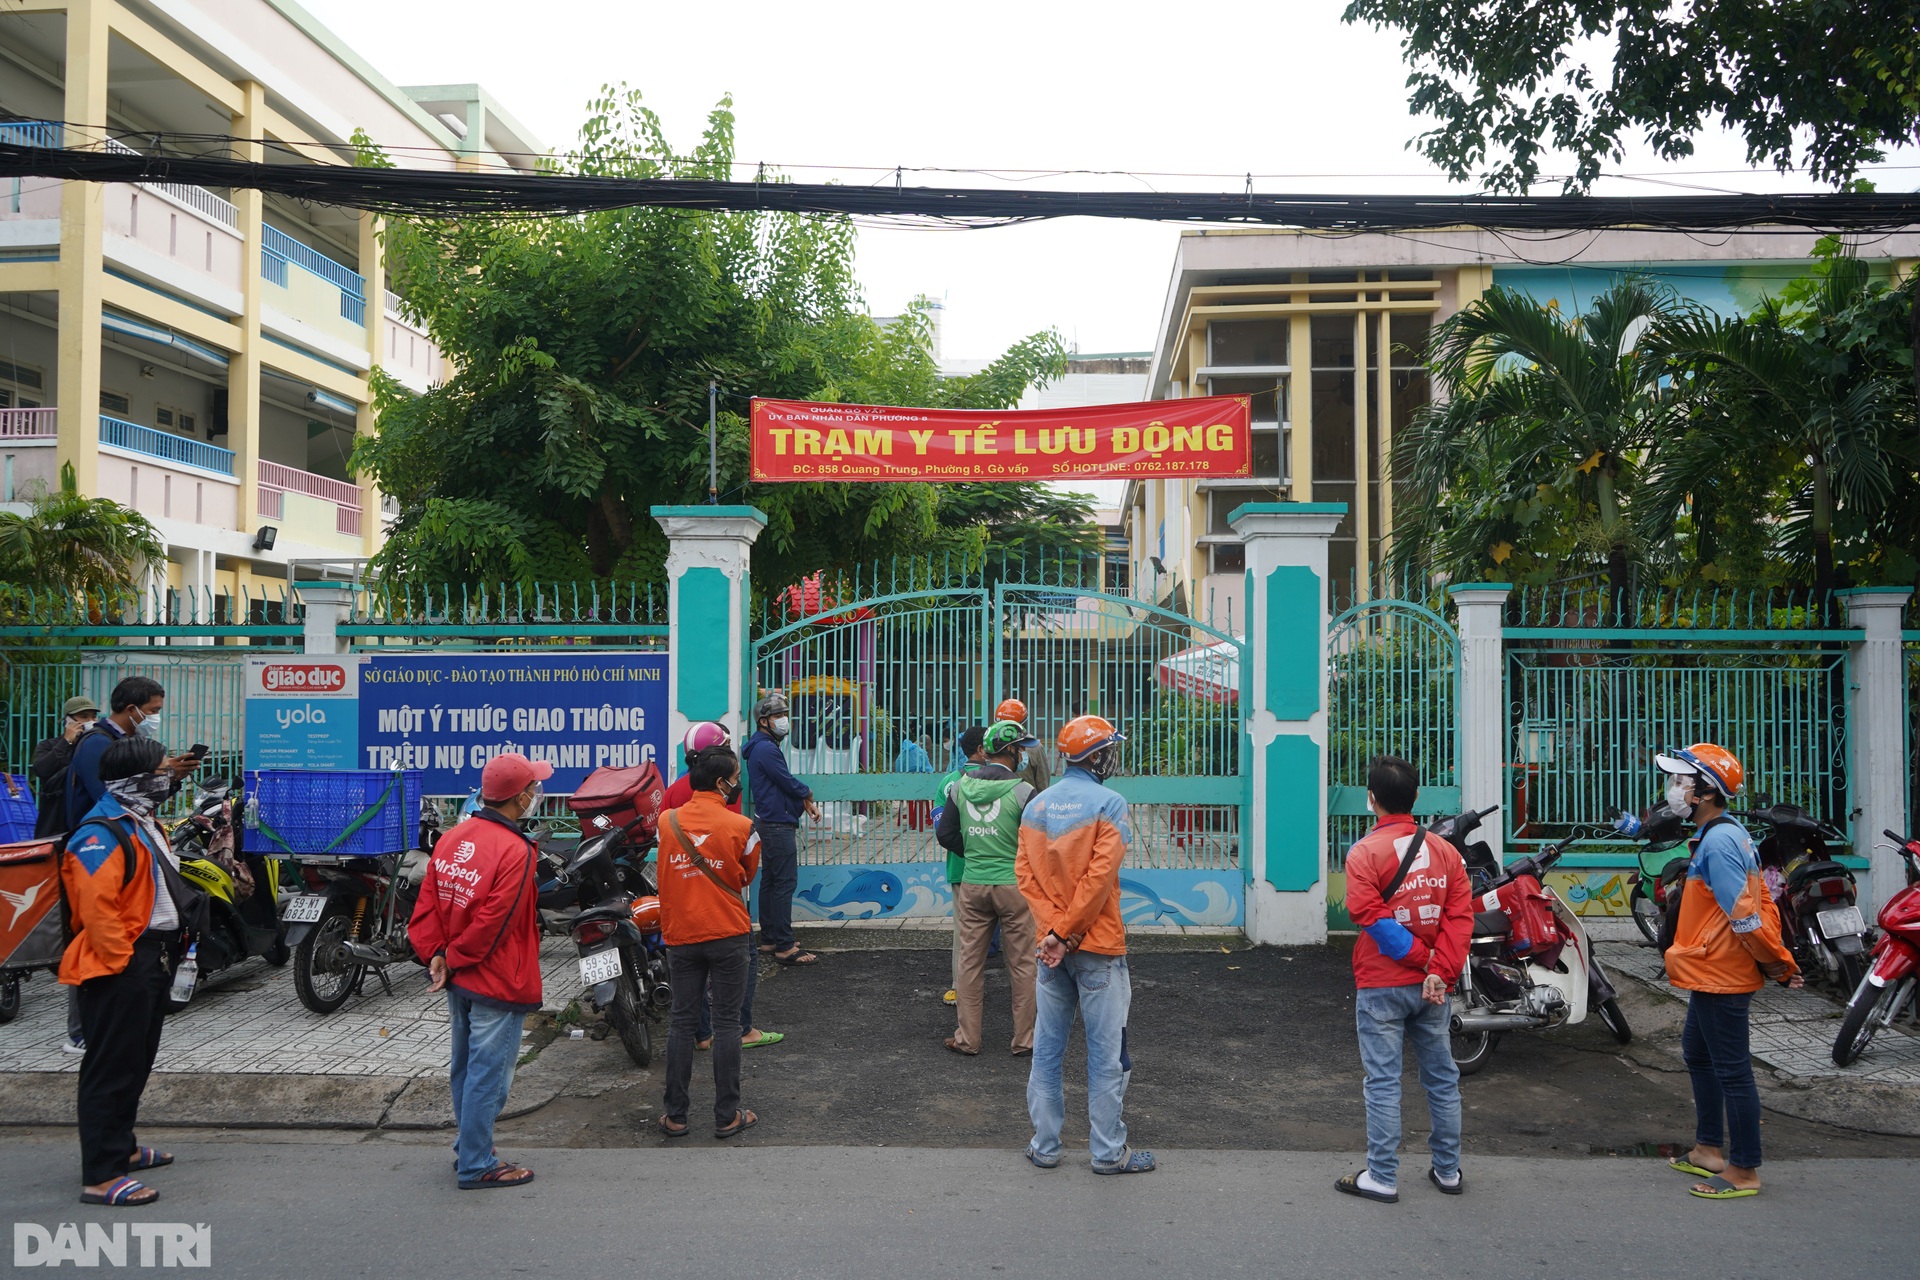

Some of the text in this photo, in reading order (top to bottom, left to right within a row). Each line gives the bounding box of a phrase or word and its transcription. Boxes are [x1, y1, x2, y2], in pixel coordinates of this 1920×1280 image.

[768, 412, 783, 421] ỦY
[812, 414, 843, 422] NHÂN
[846, 414, 869, 422] DÂN
[872, 414, 919, 422] PHƯỜNG
[864, 406, 886, 414] VẤP
[768, 420, 1234, 461] TRẠM Y TẾ LƯU ĐỘNG
[793, 462, 1029, 476] ĐC: 858 Quang Trung, Phường 8, Gò vấp
[1052, 460, 1210, 473] SỐ HOTLINE: 0762.187.178
[266, 667, 341, 690] giáo dục
[364, 667, 381, 684] SỞ
[383, 666, 415, 684] GIÁO
[416, 670, 442, 686] DỤC
[451, 666, 478, 683] ĐÀO
[480, 669, 506, 686] TẠO
[508, 666, 551, 682] THÀNH
[553, 665, 579, 682] PHỐ
[581, 665, 600, 682] HỒ
[602, 664, 625, 682] CHÍ
[627, 668, 660, 681] MINH
[276, 703, 326, 730] yola
[378, 703, 645, 738] MỘT Ý THỨC GIAO THÔNG
[434, 746, 465, 774] NỤ
[596, 739, 656, 768] PHÚC
[1048, 802, 1082, 811] AhaMove
[968, 826, 998, 836] gojek
[670, 854, 724, 870] LALOVE
[434, 858, 482, 886] MrSpedy
[293, 898, 319, 908] 59-N1
[286, 910, 318, 920] 082.03
[586, 952, 614, 970] 59-S2
[584, 963, 619, 984] 695.89
